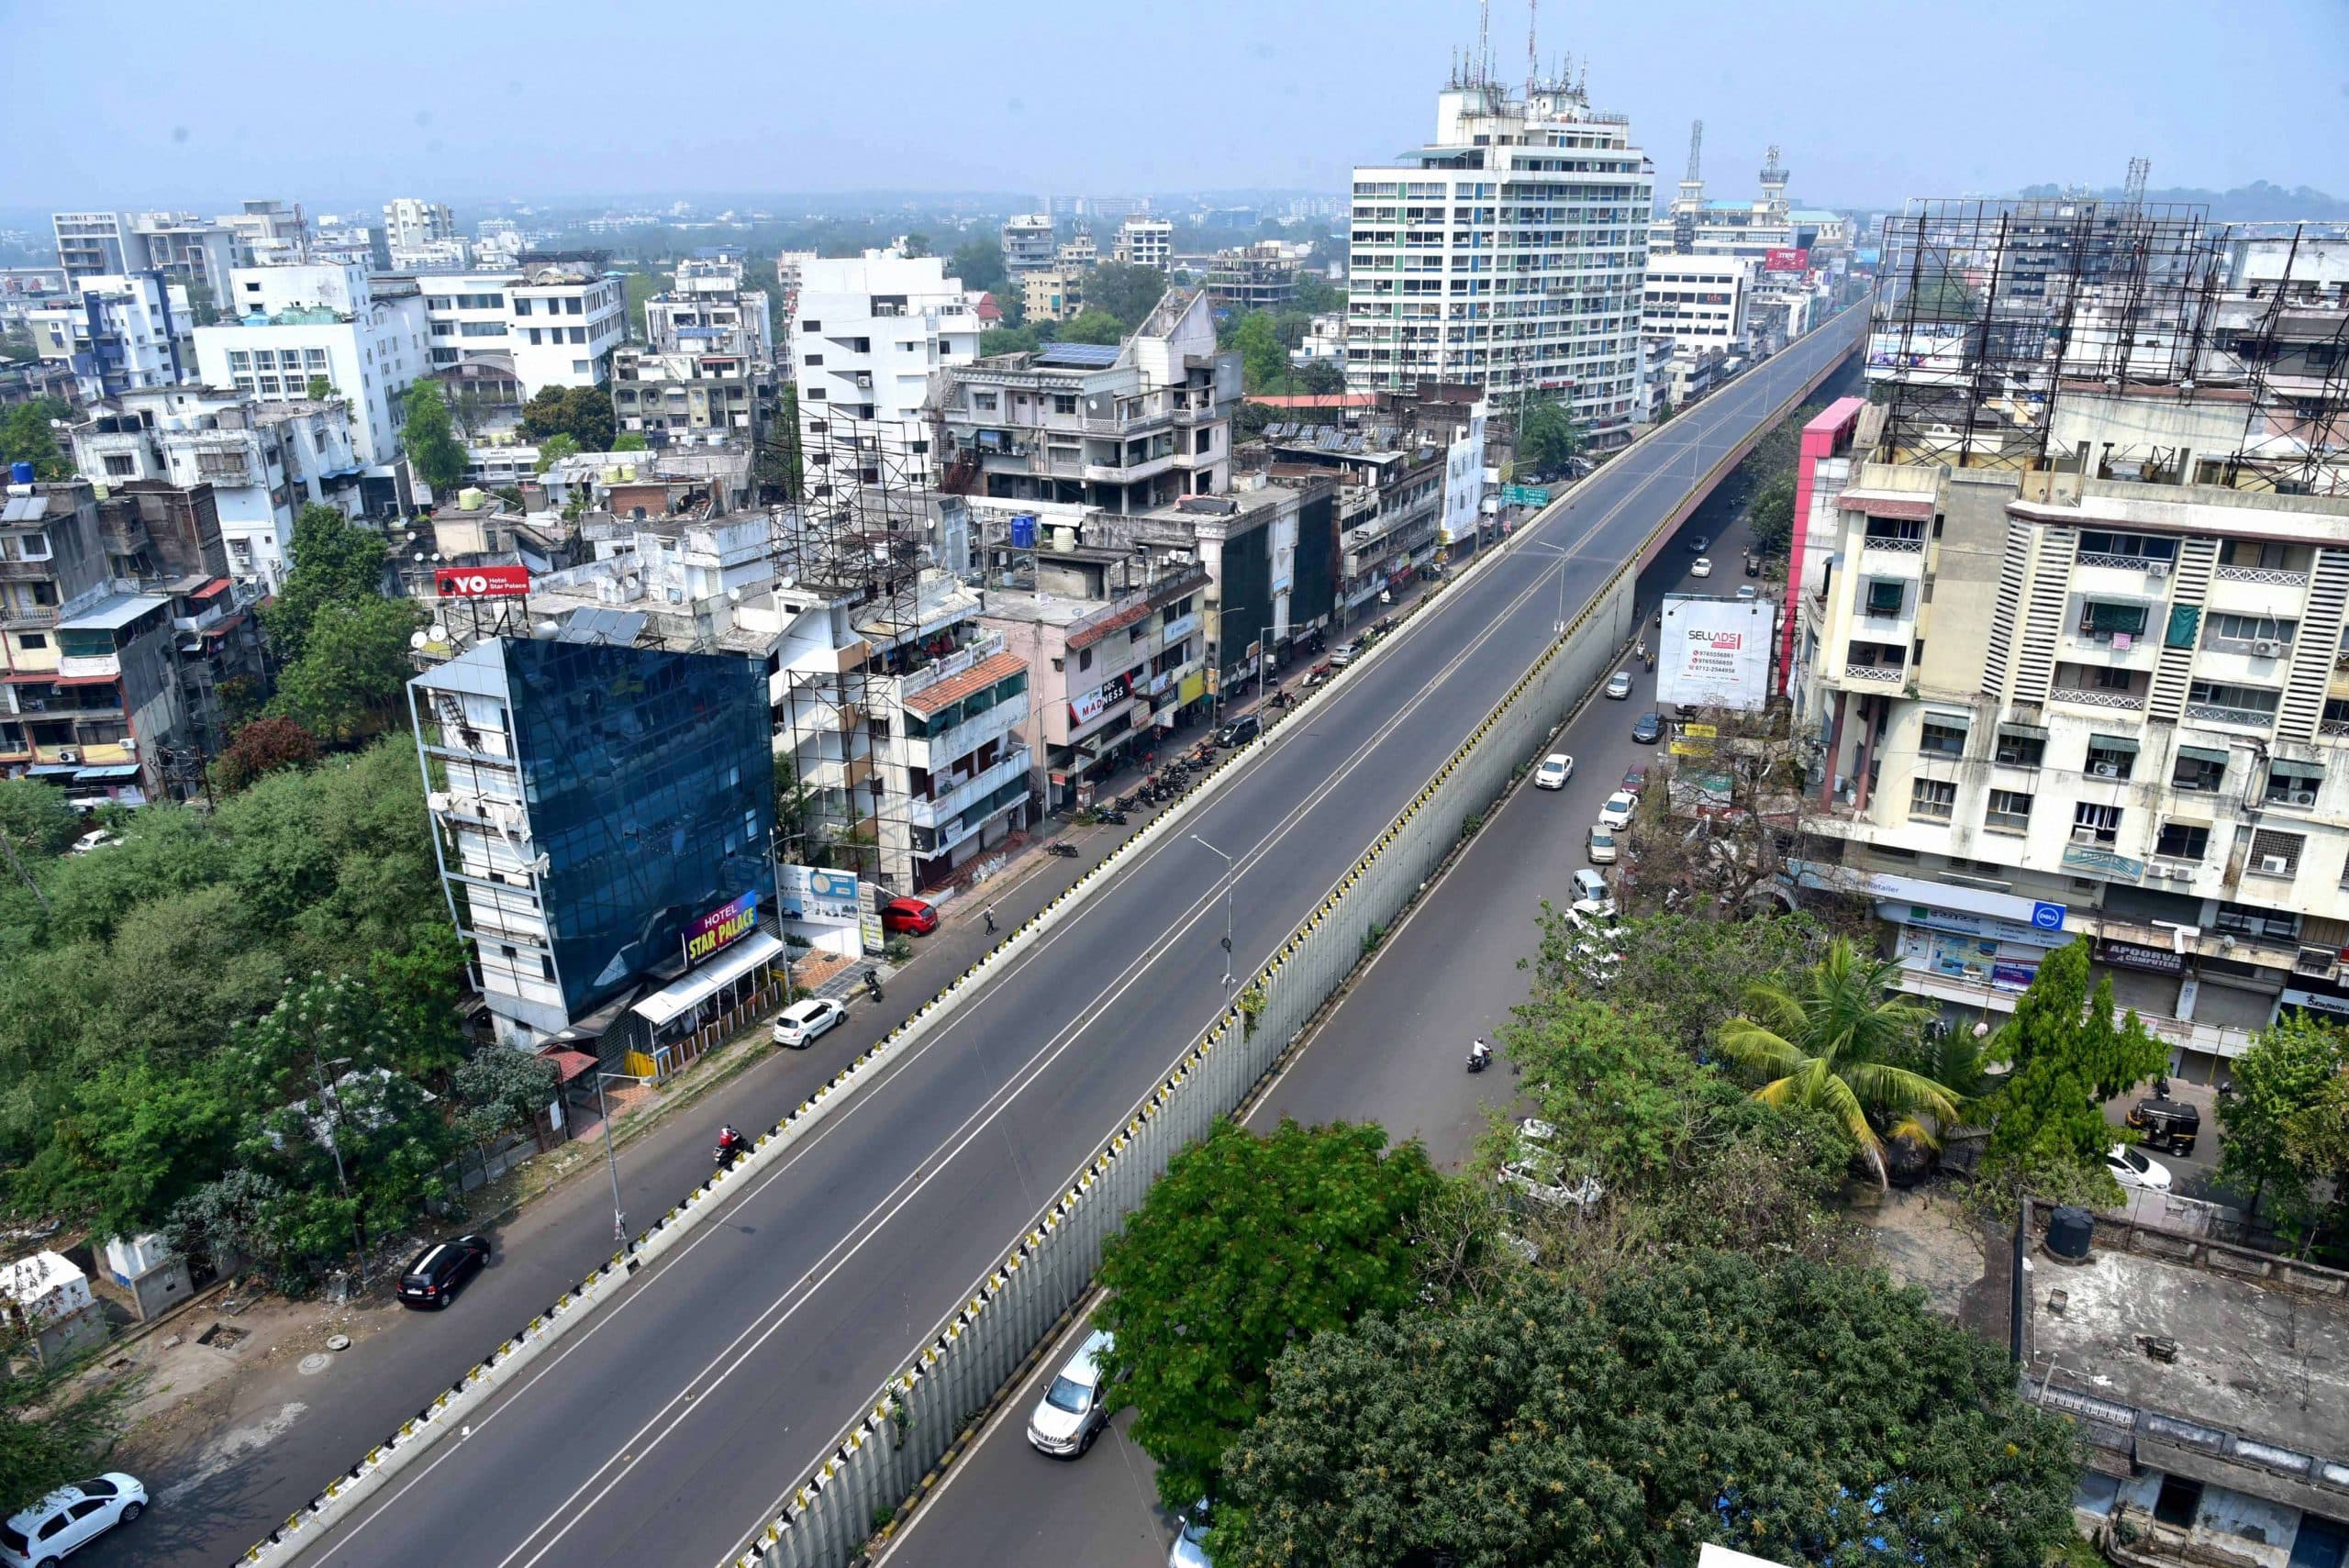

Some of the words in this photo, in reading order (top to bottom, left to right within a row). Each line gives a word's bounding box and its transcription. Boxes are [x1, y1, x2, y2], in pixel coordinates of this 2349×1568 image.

[1688, 630, 1737, 643] SELLADS
[1082, 686, 1124, 717] MADNESS
[704, 904, 738, 929] HOTEL
[2040, 912, 2057, 921] DELL
[688, 929, 717, 960] STAR
[718, 906, 755, 943] PALACE
[2110, 944, 2182, 963] APOORVA
[2125, 954, 2181, 970] COMPUTERS
